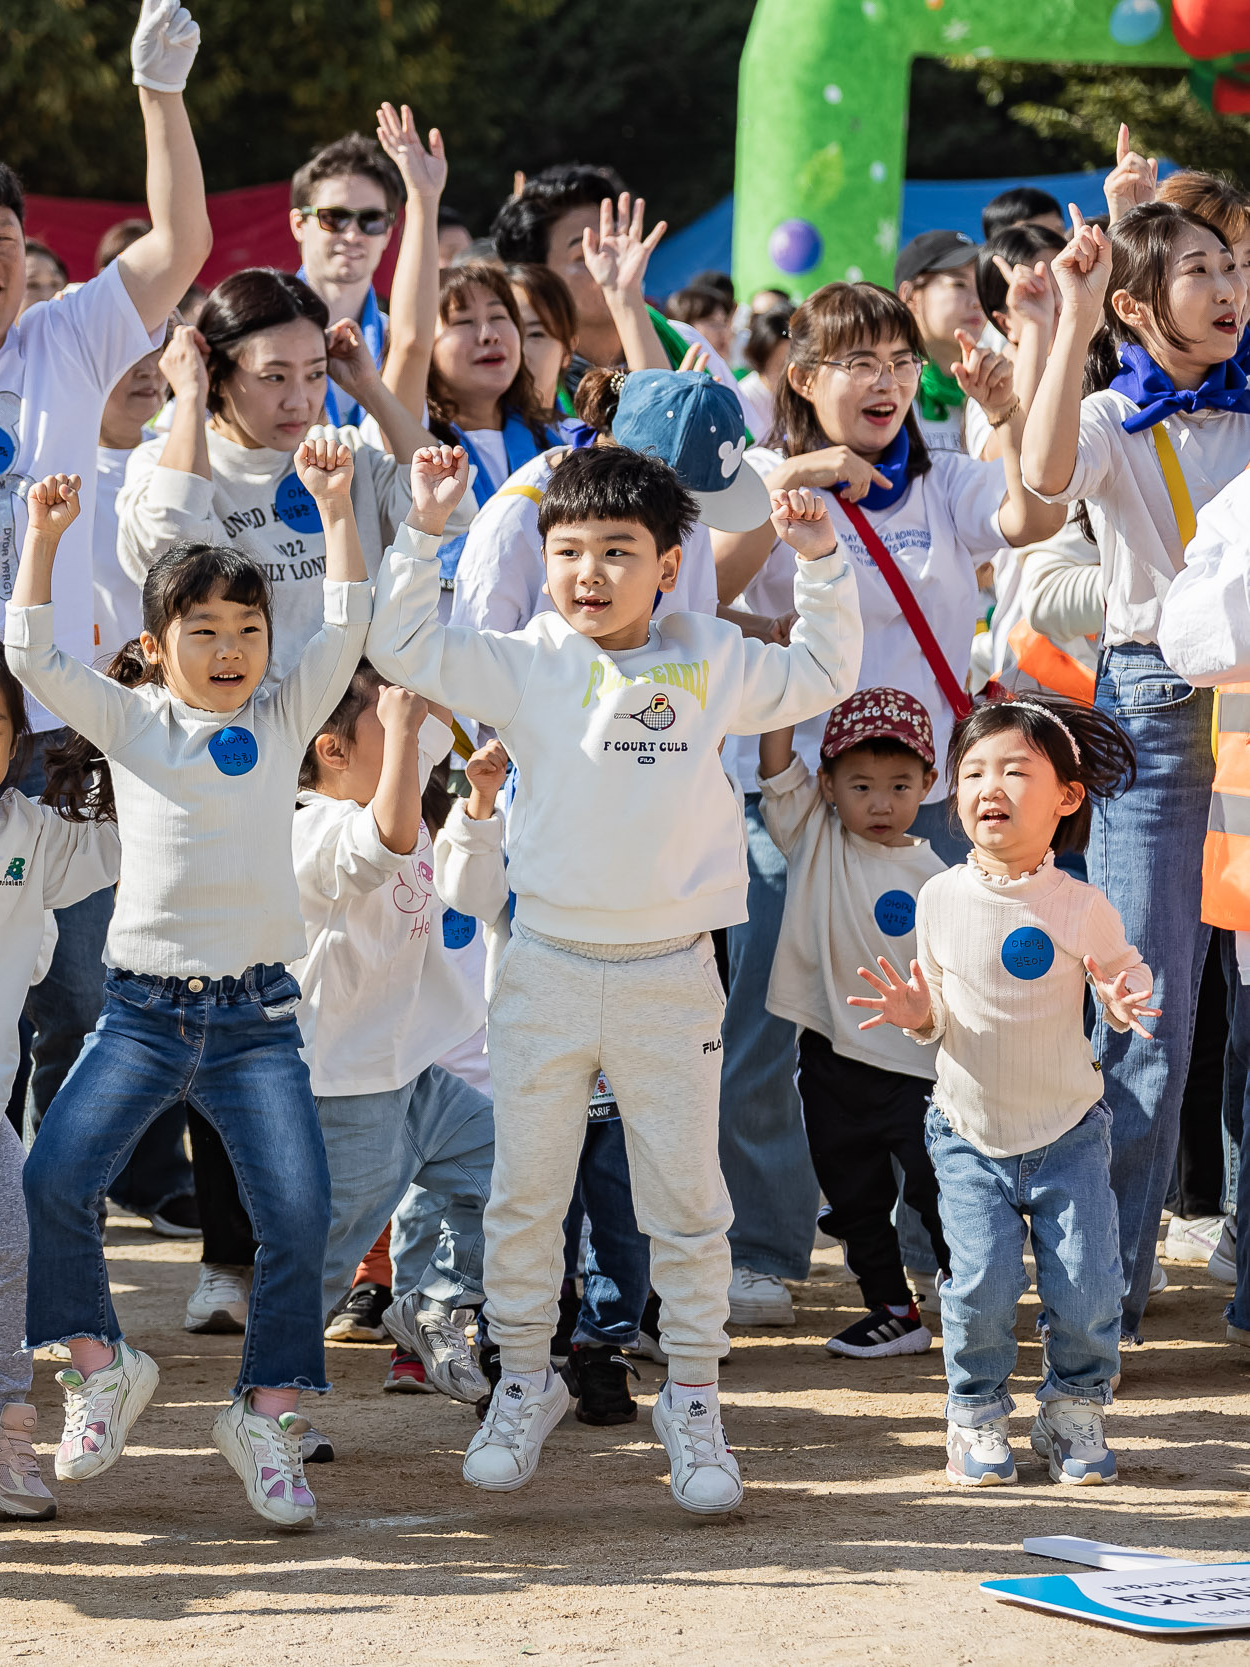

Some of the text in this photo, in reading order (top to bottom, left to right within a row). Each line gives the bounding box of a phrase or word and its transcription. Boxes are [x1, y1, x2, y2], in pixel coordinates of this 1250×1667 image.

[603, 741, 689, 752] F COURT CULB
[1012, 955, 1044, 968] 김도아
[702, 1038, 723, 1055] FILA
[587, 1105, 611, 1118] HARIF
